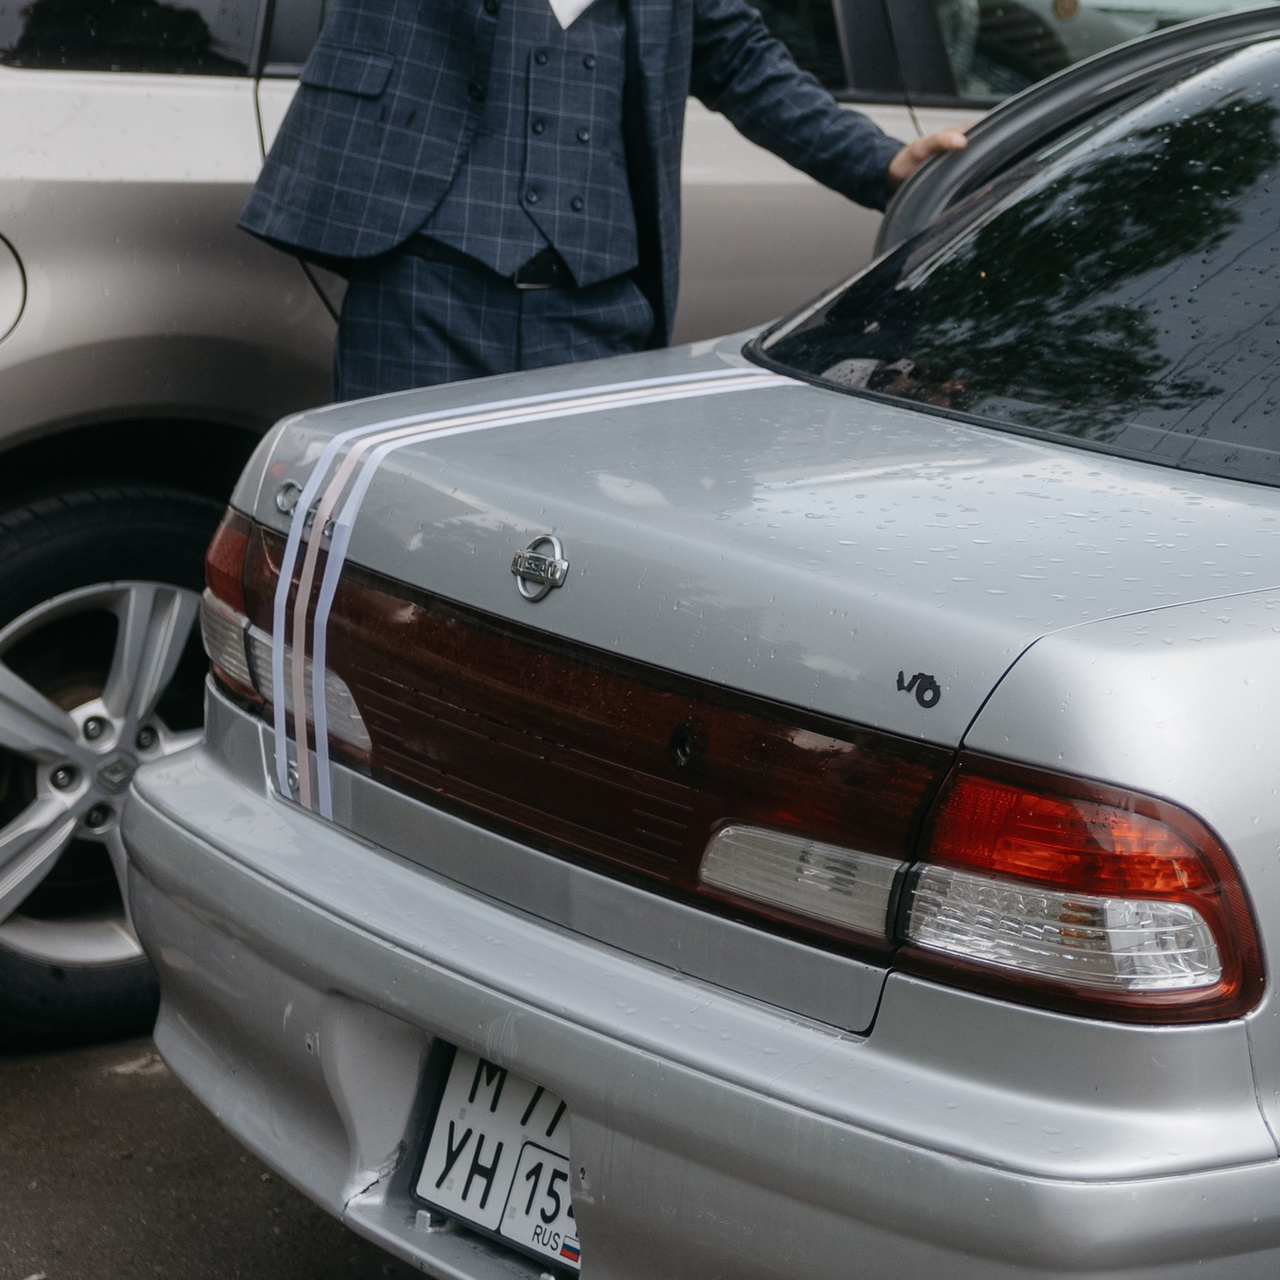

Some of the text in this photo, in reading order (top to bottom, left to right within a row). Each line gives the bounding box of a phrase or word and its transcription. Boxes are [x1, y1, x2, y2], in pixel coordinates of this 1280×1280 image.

[515, 553, 562, 580] NISSAN
[525, 1161, 576, 1228] 15
[532, 1224, 561, 1251] RUS
